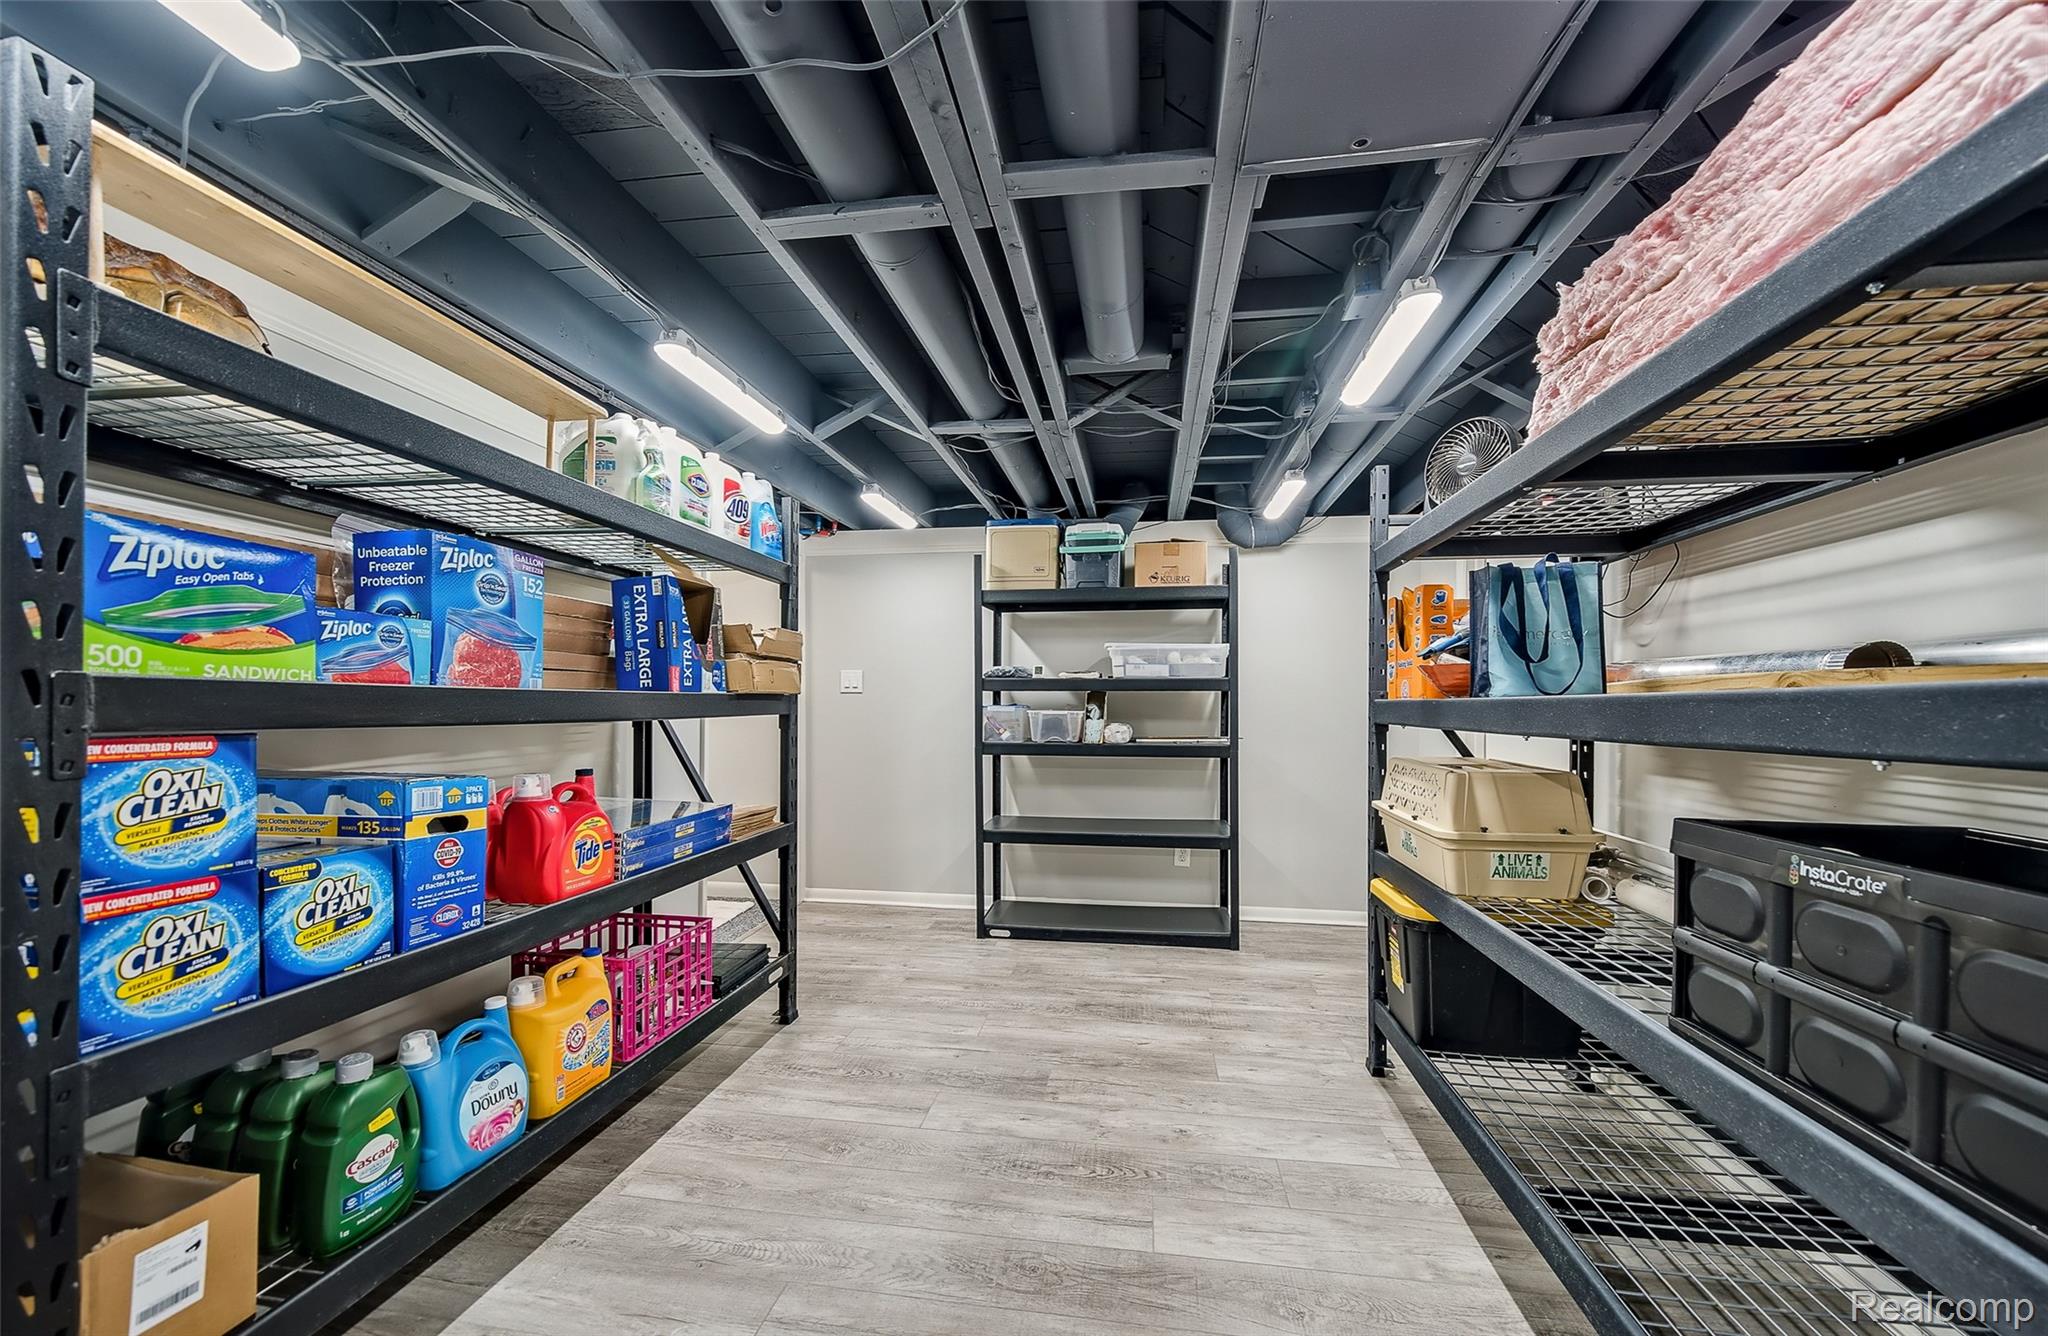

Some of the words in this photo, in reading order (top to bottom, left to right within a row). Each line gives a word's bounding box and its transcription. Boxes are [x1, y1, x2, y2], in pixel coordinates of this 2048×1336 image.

[727, 499, 750, 520] 409
[107, 535, 226, 577] Ziploc
[357, 544, 428, 559] Unbeatable
[440, 547, 495, 573] Ziploc
[514, 553, 544, 569] GALLON
[368, 560, 415, 573] Freezer
[522, 564, 544, 575] FREEZER
[175, 574, 201, 585] Easy
[202, 572, 230, 584] Open
[232, 571, 254, 582] Tabs
[360, 573, 426, 588] Protection
[522, 576, 543, 595] 152
[1160, 575, 1191, 583] KEURIG
[623, 600, 630, 609] 33
[633, 584, 649, 635] EXTRA
[320, 620, 372, 641] Ziploc
[624, 611, 632, 641] GALLON
[88, 644, 142, 668] 500
[624, 650, 632, 672] Bags
[637, 638, 653, 688] LARGE
[683, 638, 693, 687] EXTRA
[202, 663, 313, 682] SANDWICH
[104, 743, 172, 754] CONCENTRATED
[173, 741, 213, 751] FORMULA
[143, 768, 204, 799] OXI
[118, 784, 222, 827] CLEAN
[380, 798, 393, 806] UP
[448, 795, 461, 804] UP
[309, 819, 329, 827] Longer
[357, 820, 380, 835] 135
[126, 827, 161, 839] VERSATILE
[139, 840, 159, 849] MAX
[163, 829, 205, 842] EFFICIENCY
[436, 847, 462, 859] COVID-19
[575, 839, 600, 870] Tide
[1507, 853, 1533, 867] LIVE
[269, 862, 318, 878] CONCENTRATED
[432, 873, 446, 881] Kills
[1491, 865, 1548, 880] ANIMALS
[1800, 860, 1885, 894] InstaCrate
[105, 889, 173, 910] CONCENTRATED
[175, 881, 216, 897] FORMULA
[315, 876, 356, 903] OXI
[417, 884, 425, 892] of
[425, 880, 450, 891] Bacteria
[298, 887, 369, 930] CLEAN
[436, 909, 459, 923] CLOROX
[145, 911, 206, 948] OXI
[119, 925, 225, 979] CLEAN
[128, 975, 163, 992] VERSATILE
[141, 988, 162, 1000] MAX
[164, 971, 208, 991] EFFICIENCY
[471, 1081, 519, 1117] Downy
[347, 1138, 399, 1176] Cascade
